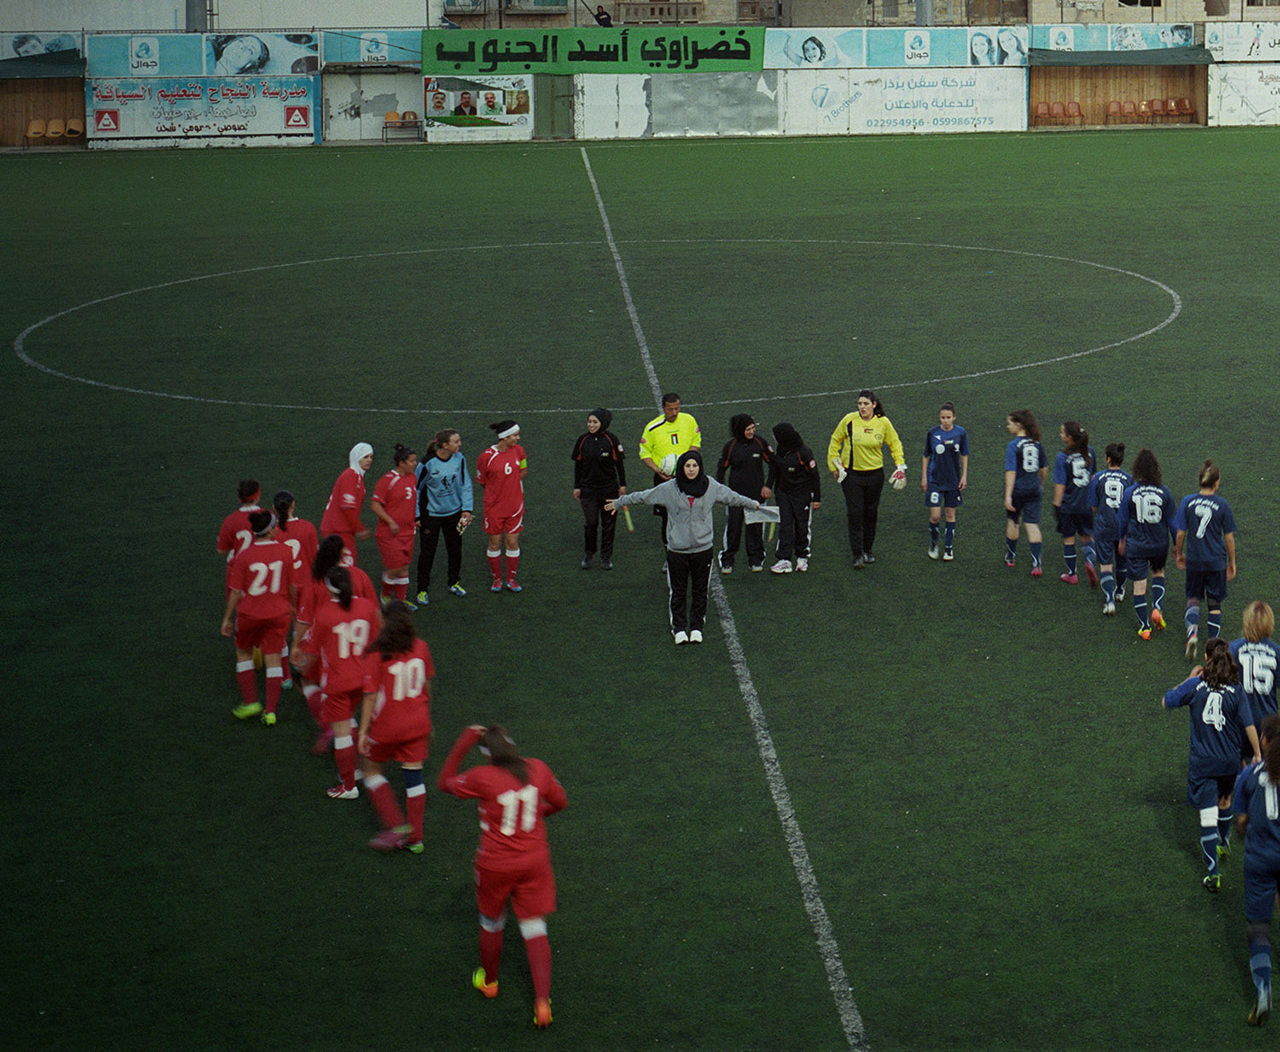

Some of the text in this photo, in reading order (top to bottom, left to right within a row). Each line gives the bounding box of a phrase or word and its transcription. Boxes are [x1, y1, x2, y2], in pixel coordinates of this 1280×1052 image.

[131, 60, 158, 69] جوال
[435, 29, 752, 73] خضراوي أسد الجنوب
[906, 52, 929, 60] جوال
[94, 81, 307, 105] مدرسة النجاح لتعليم السياقة
[940, 75, 976, 90] شركة
[830, 90, 863, 119] Brothers
[931, 98, 974, 111] للدعاية
[866, 119, 925, 128] 022954956
[932, 117, 994, 126] 0599867575
[504, 462, 513, 475] 6
[1022, 444, 1040, 473] 8
[1071, 458, 1090, 488] 5
[404, 486, 412, 500] 3
[1104, 480, 1125, 509] 9
[1131, 493, 1163, 524] 16
[1194, 504, 1213, 540] 7
[248, 560, 284, 597] 21
[332, 618, 371, 660] 19
[387, 657, 427, 701] 10
[1238, 652, 1278, 695] 15
[1202, 691, 1227, 732] 4
[496, 783, 539, 836] 11
